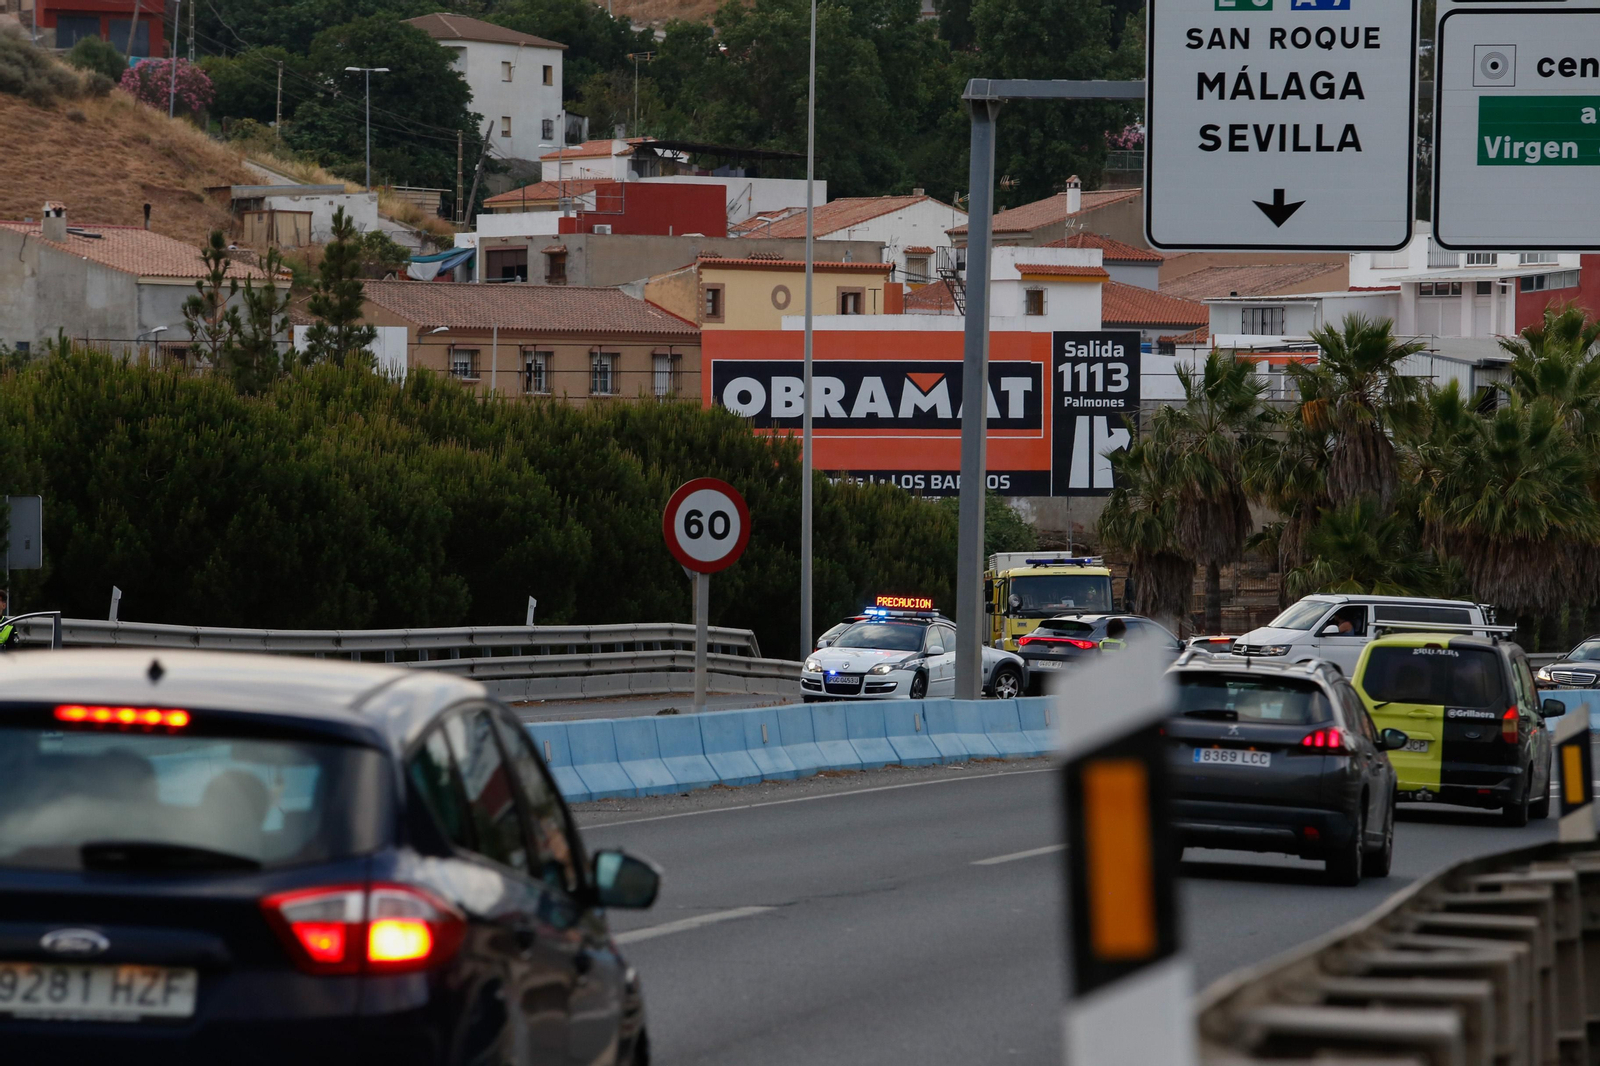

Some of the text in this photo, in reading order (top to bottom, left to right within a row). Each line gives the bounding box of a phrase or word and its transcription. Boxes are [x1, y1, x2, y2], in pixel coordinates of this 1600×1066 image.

[1185, 26, 1381, 51] SAN ROQUE
[1536, 56, 1600, 78] cen
[1196, 65, 1365, 101] MÁLAGA
[1580, 106, 1600, 124] a
[1197, 123, 1363, 153] SEVILLA
[1483, 135, 1579, 164] Virgen
[1064, 340, 1125, 358] Salida
[1057, 362, 1130, 393] 1113
[1063, 395, 1125, 408] Palmones
[891, 474, 925, 490] LOS
[930, 474, 1011, 490] BAOS
[683, 508, 731, 541] 60
[876, 596, 932, 609] PRECAUCION
[1446, 708, 1496, 719] @Grillaera
[1203, 750, 1269, 765] 8369 LCC
[0, 966, 188, 1007] 9281 HZF
